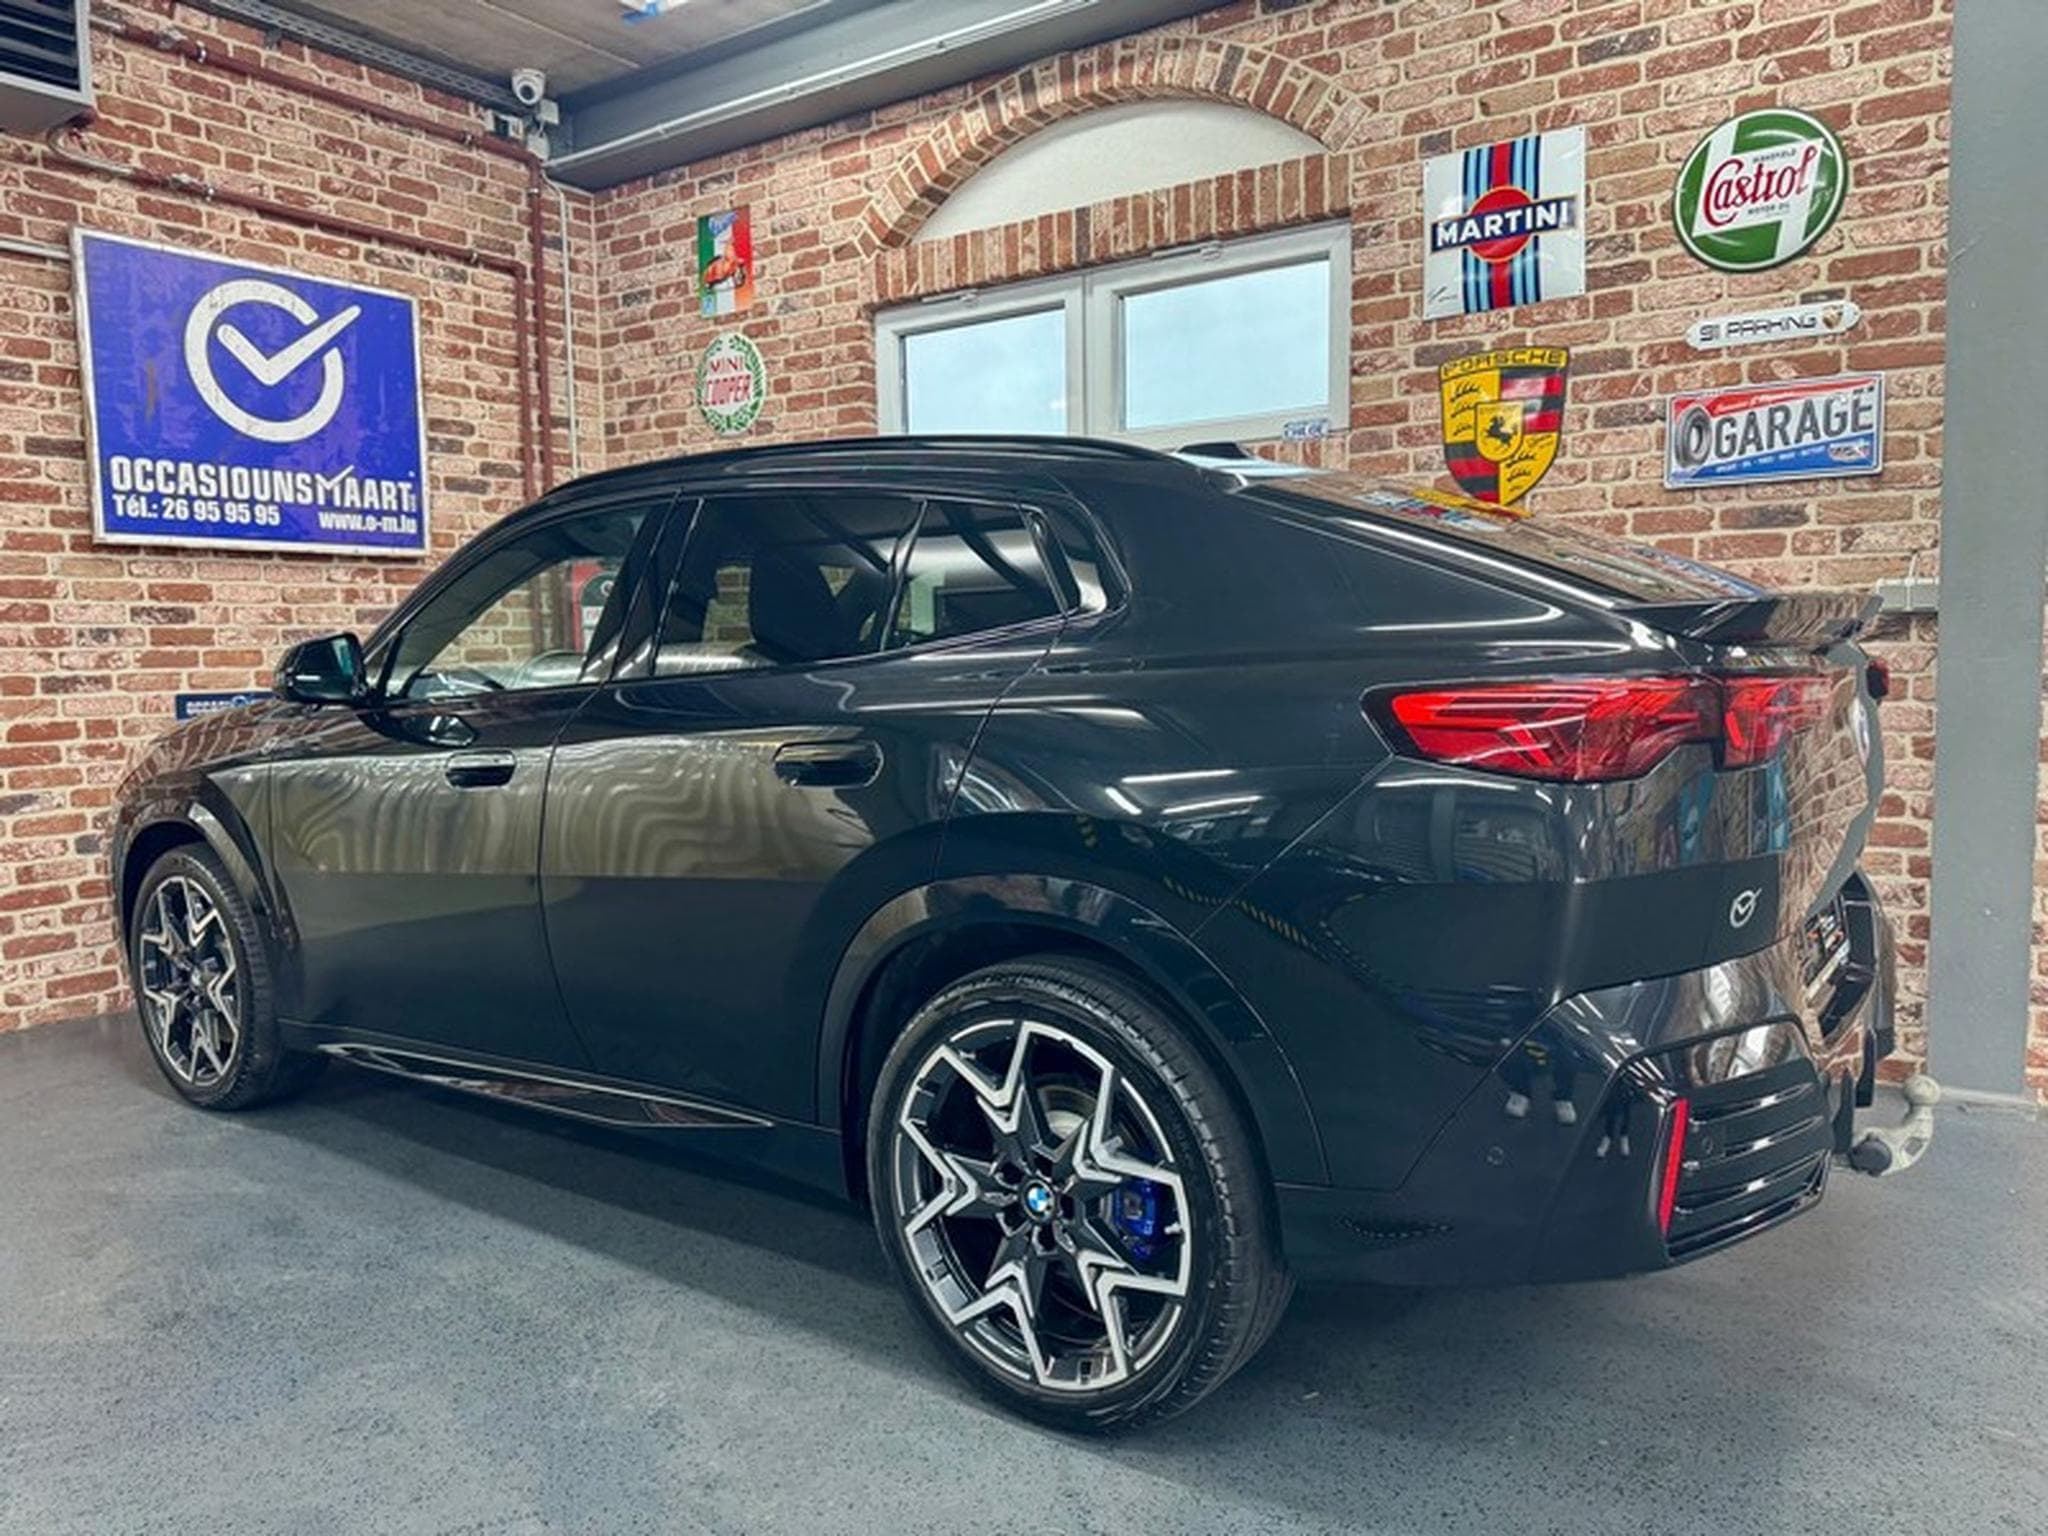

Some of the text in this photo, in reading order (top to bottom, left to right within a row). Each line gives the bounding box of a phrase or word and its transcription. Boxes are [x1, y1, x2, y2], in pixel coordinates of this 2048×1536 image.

[1703, 145, 1818, 227] Castrol
[1436, 201, 1568, 247] MARTINI
[1727, 316, 1817, 337] PARKING
[710, 356, 744, 373] MINI
[1443, 350, 1563, 377] PORSCHE
[704, 374, 751, 406] COOPER
[1714, 391, 1874, 459] GARAGE
[110, 455, 413, 512] OCCASIOUNSMAART
[113, 493, 280, 526] Tél.: 26 95 95 95
[318, 511, 417, 533] www.o-m.lu
